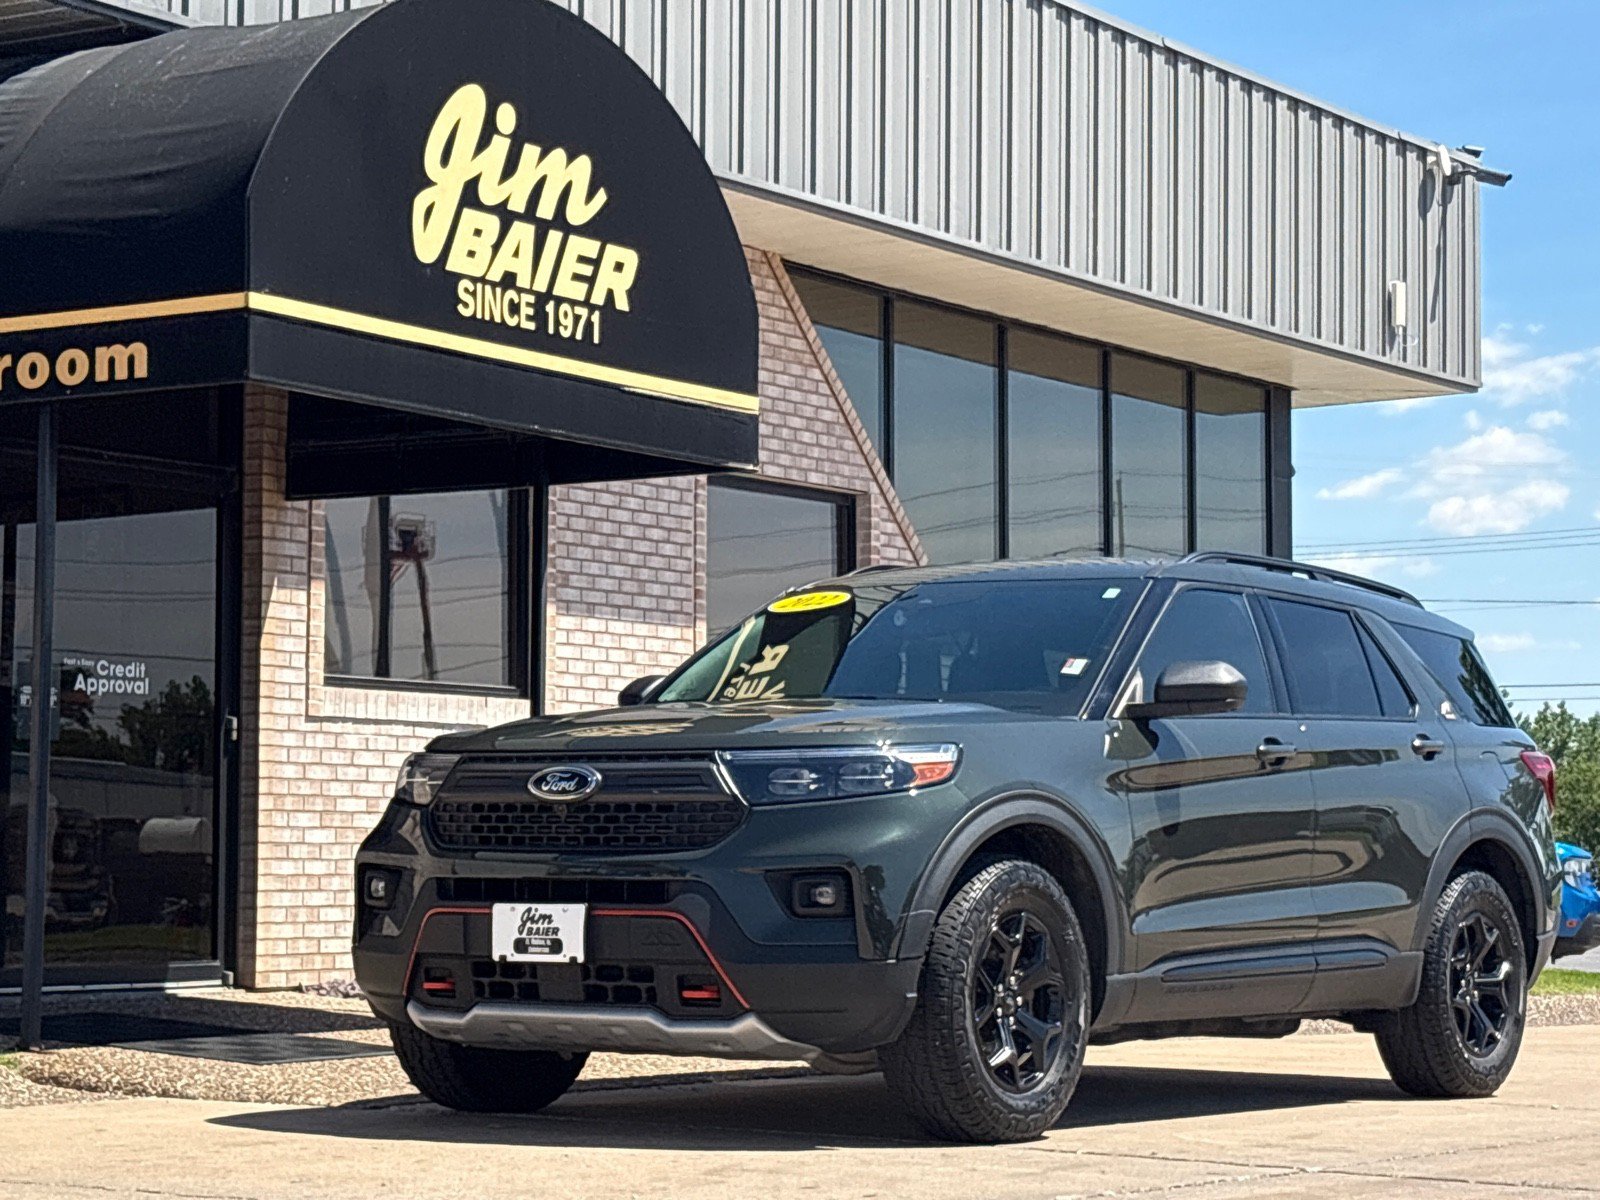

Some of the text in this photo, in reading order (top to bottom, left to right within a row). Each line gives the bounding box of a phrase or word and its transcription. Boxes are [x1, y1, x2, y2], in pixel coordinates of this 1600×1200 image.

[412, 83, 608, 264] Jim
[445, 207, 639, 312] BAIER
[457, 279, 601, 344] SINCE 1971
[97, 660, 146, 678] Credit
[74, 673, 149, 696] Approval
[541, 772, 579, 791] Ford
[517, 906, 554, 936] Jim
[526, 927, 560, 936] BAIER
